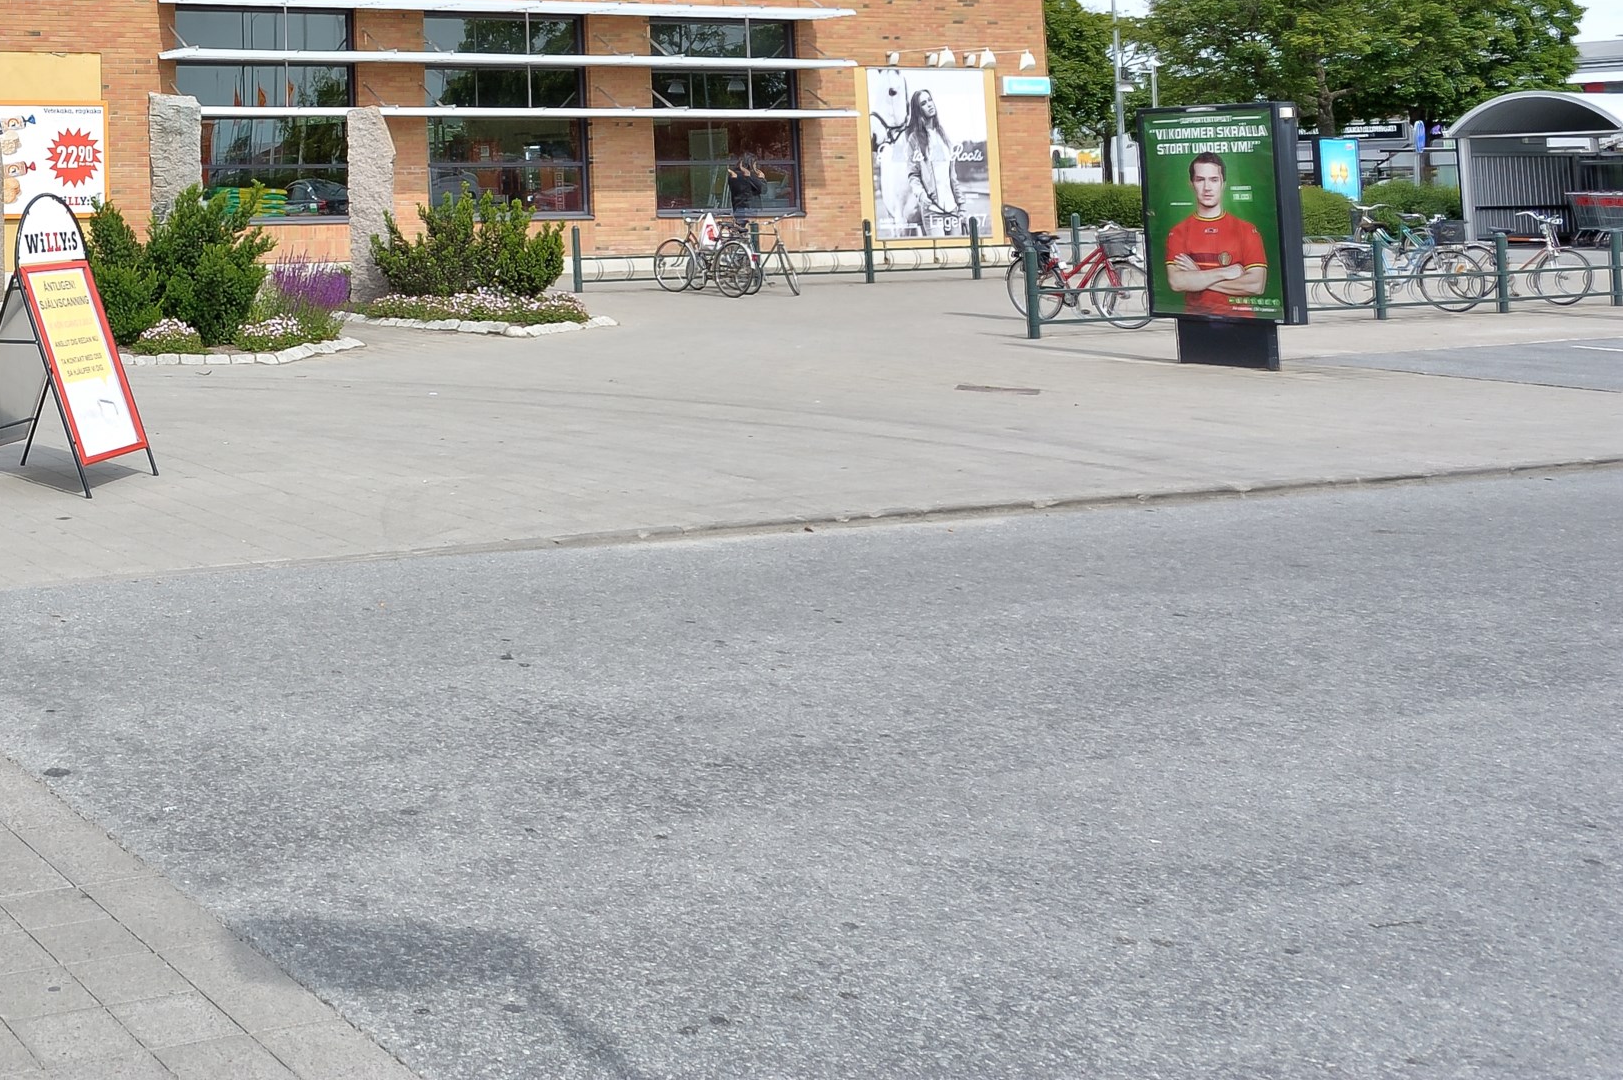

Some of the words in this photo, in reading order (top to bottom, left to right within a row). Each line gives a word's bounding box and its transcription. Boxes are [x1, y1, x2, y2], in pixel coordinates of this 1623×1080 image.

[1168, 126, 1215, 139] KOMMER
[1216, 122, 1269, 138] SKRÄLLA
[1156, 142, 1192, 155] STORT
[1192, 141, 1230, 154] UNDER
[929, 214, 964, 231] Lager
[24, 231, 78, 254] WiLLY:S
